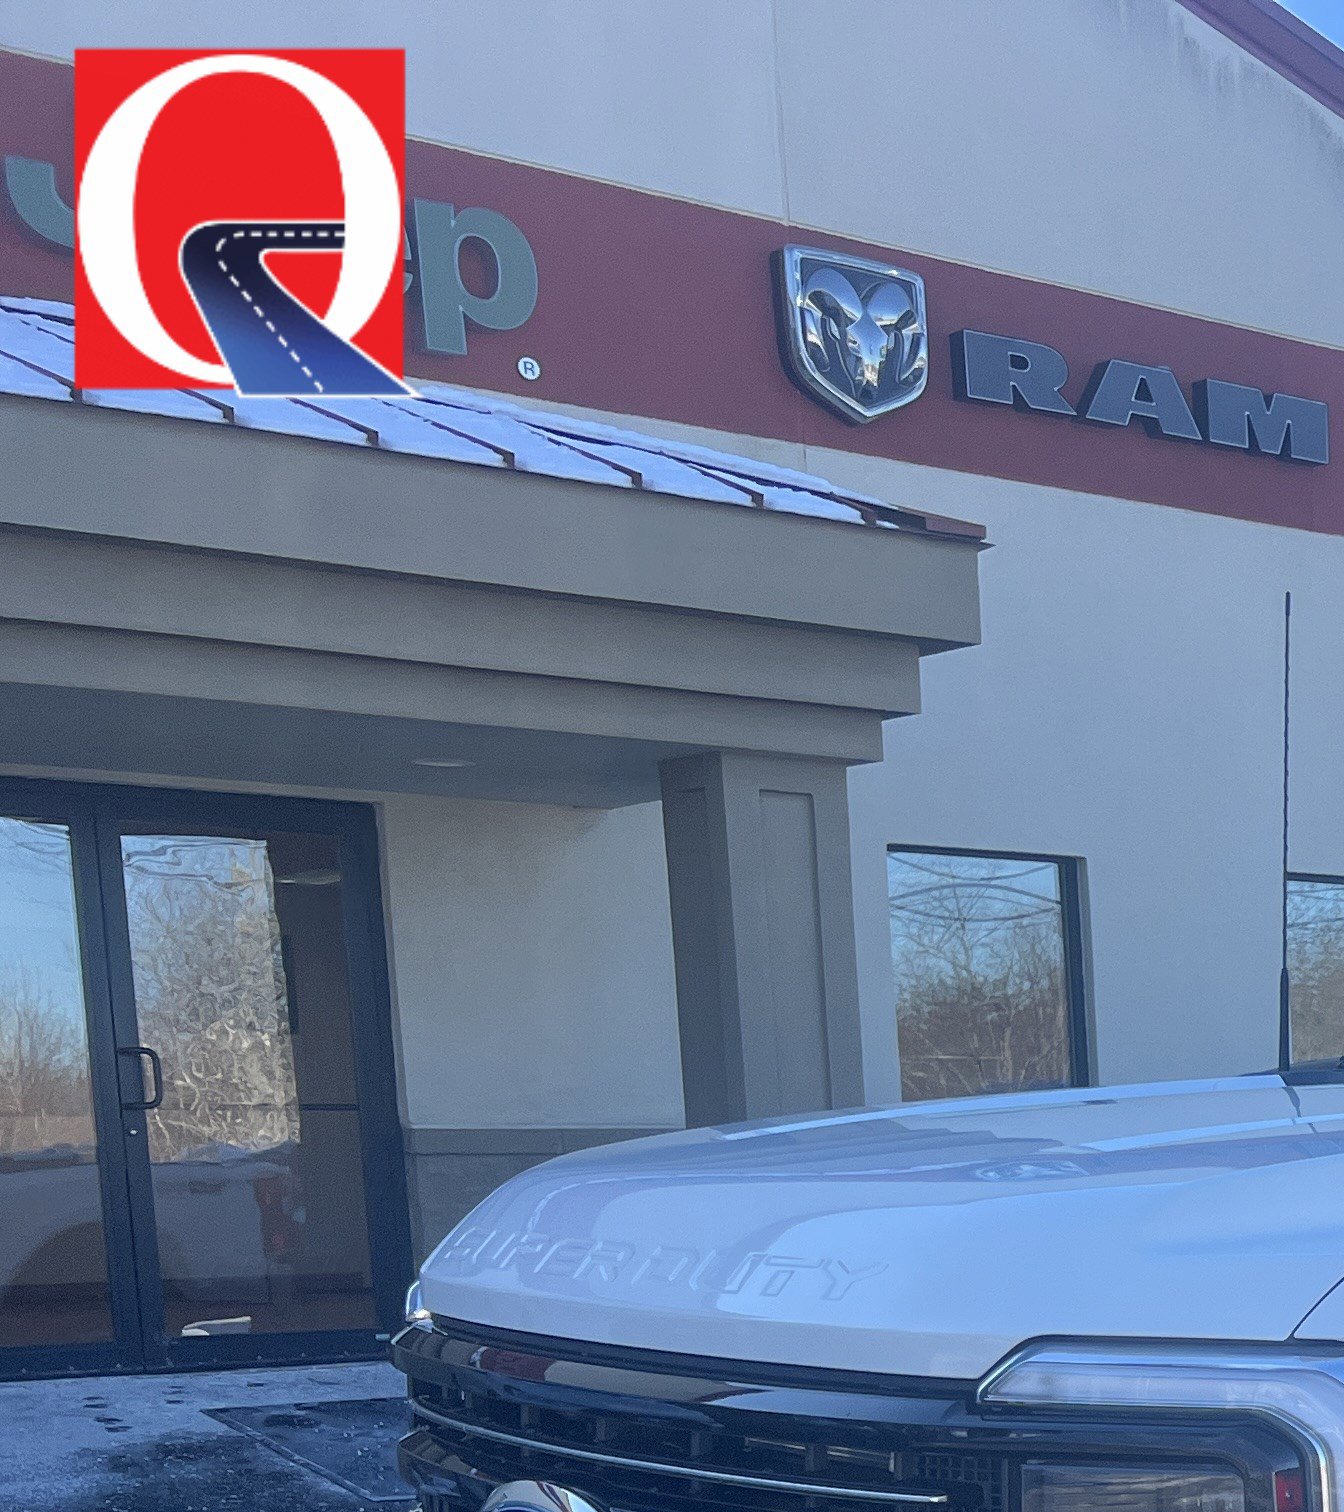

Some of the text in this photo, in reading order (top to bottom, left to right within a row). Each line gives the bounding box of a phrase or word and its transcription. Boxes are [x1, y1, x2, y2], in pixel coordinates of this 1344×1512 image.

[960, 328, 1331, 466] RAM
[444, 1226, 890, 1302] SUPER DUTY
